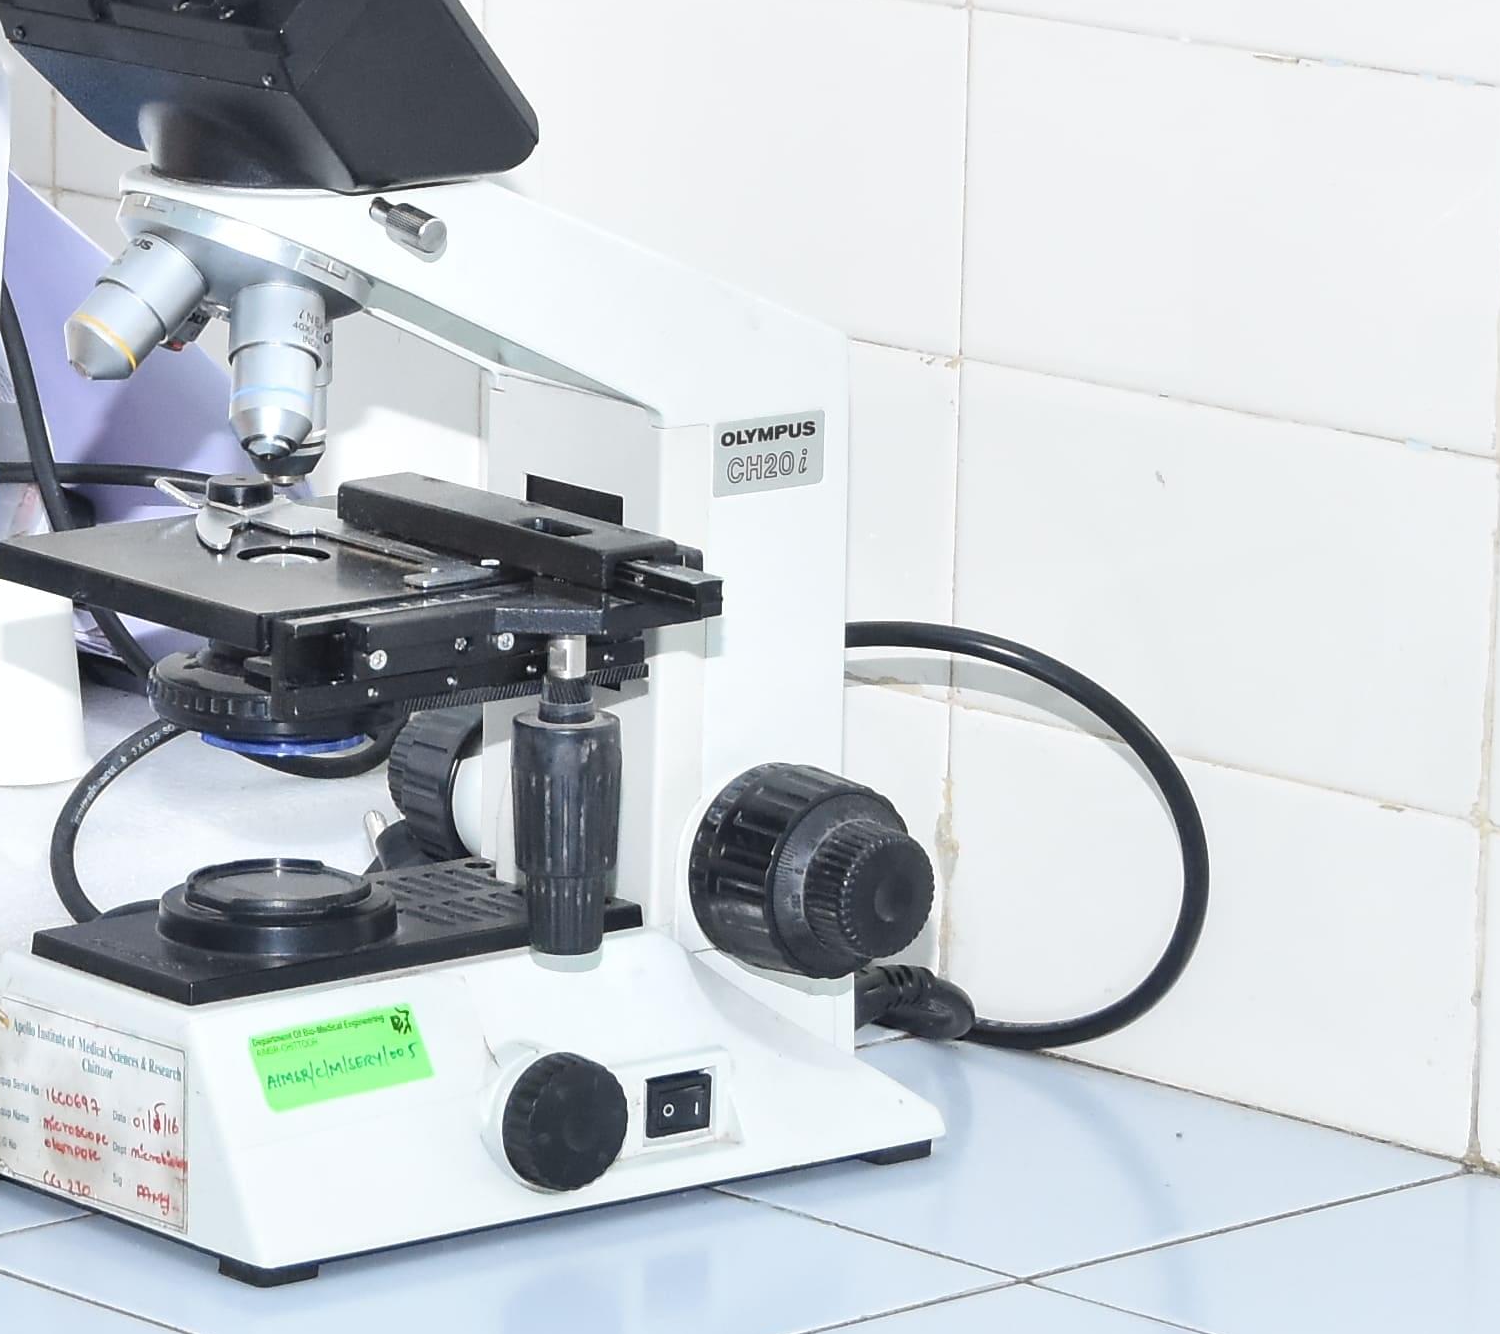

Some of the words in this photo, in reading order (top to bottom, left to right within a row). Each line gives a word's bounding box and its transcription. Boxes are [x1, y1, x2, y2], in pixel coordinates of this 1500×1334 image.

[720, 420, 816, 447] OLYMPUS
[13, 1017, 36, 1037] Apollo
[37, 1023, 66, 1049] Institute
[67, 1032, 76, 1048] of
[79, 1037, 107, 1059] Medical
[109, 1045, 139, 1068] Sciences
[140, 1056, 147, 1070] &
[149, 1058, 182, 1082] Research
[82, 1057, 114, 1079] Chittoor
